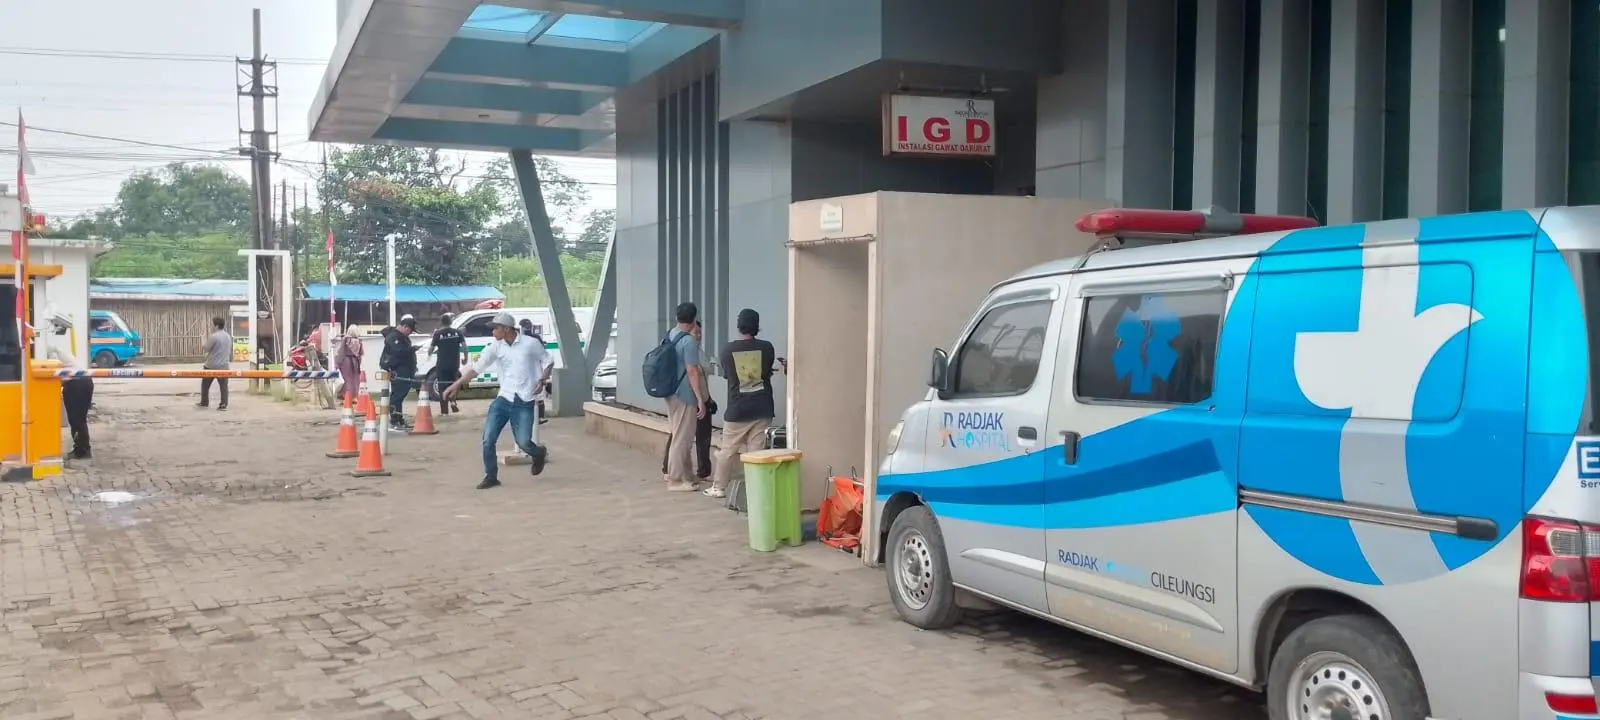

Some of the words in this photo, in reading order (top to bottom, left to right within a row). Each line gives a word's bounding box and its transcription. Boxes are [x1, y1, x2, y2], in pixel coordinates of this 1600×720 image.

[898, 143, 934, 151] INSTALASI
[958, 411, 1004, 431] RADJAK
[958, 431, 1013, 452] HOSPITAL
[1058, 548, 1100, 572] RADJAK
[1150, 571, 1216, 605] CILEUNGSI
